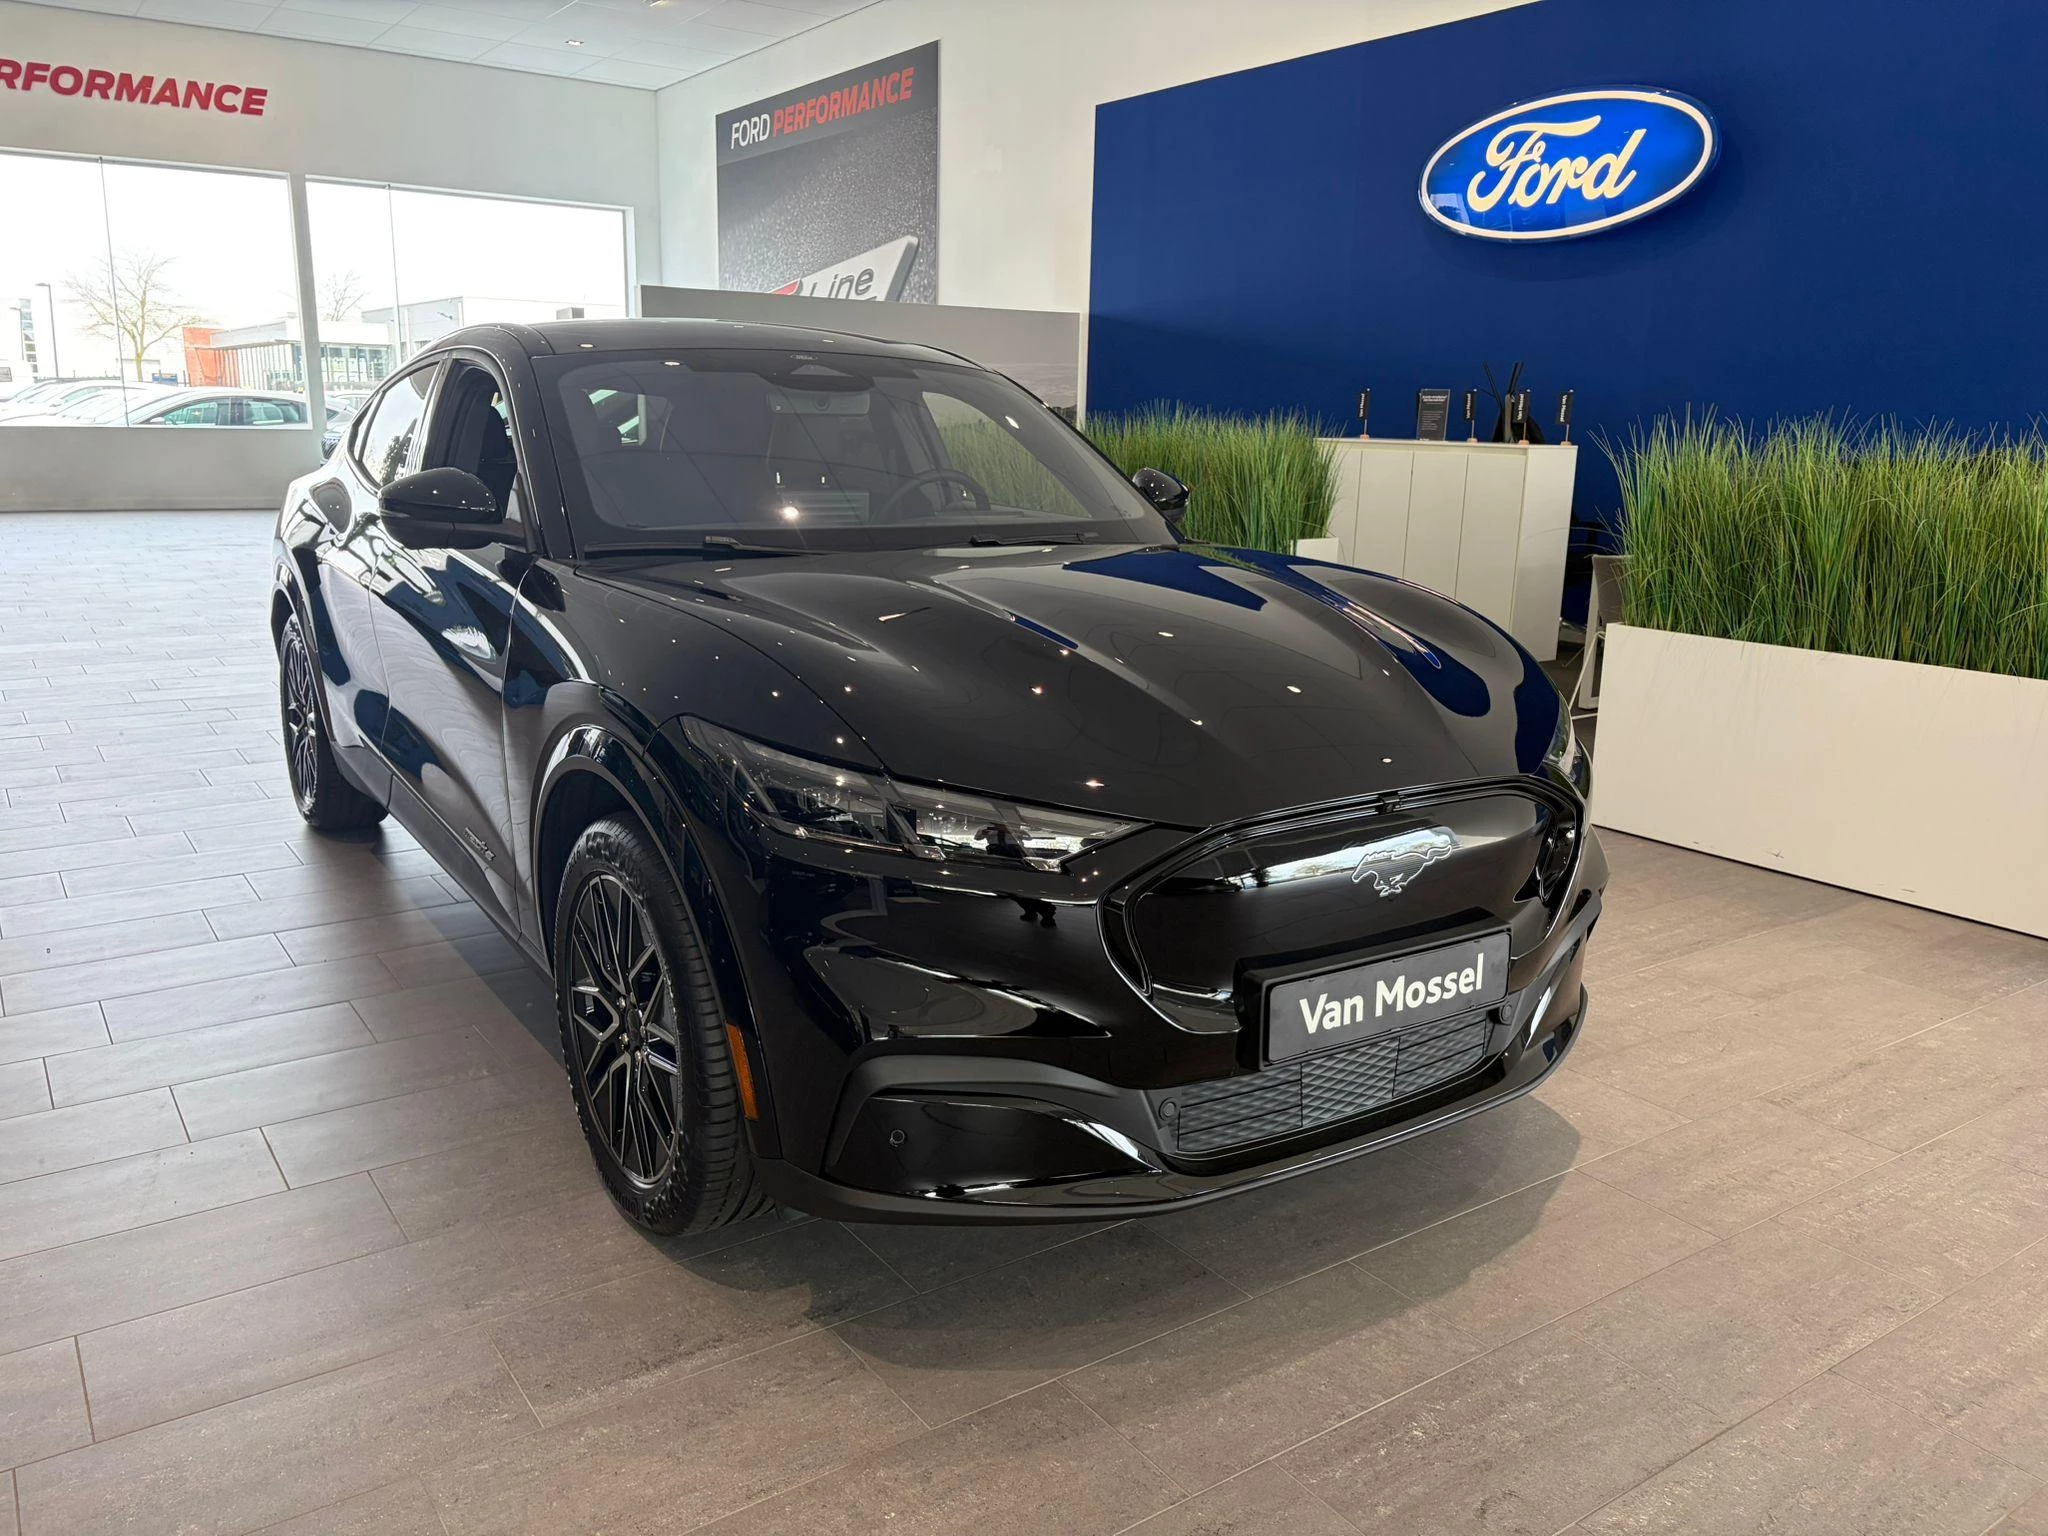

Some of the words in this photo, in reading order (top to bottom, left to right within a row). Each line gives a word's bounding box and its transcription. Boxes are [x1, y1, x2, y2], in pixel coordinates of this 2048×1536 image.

[730, 113, 771, 150] FORD
[772, 66, 915, 138] PERFORMANCE
[1467, 114, 1647, 213] Ford
[1298, 992, 1364, 1034] Van
[1374, 952, 1485, 1018] Mossel
